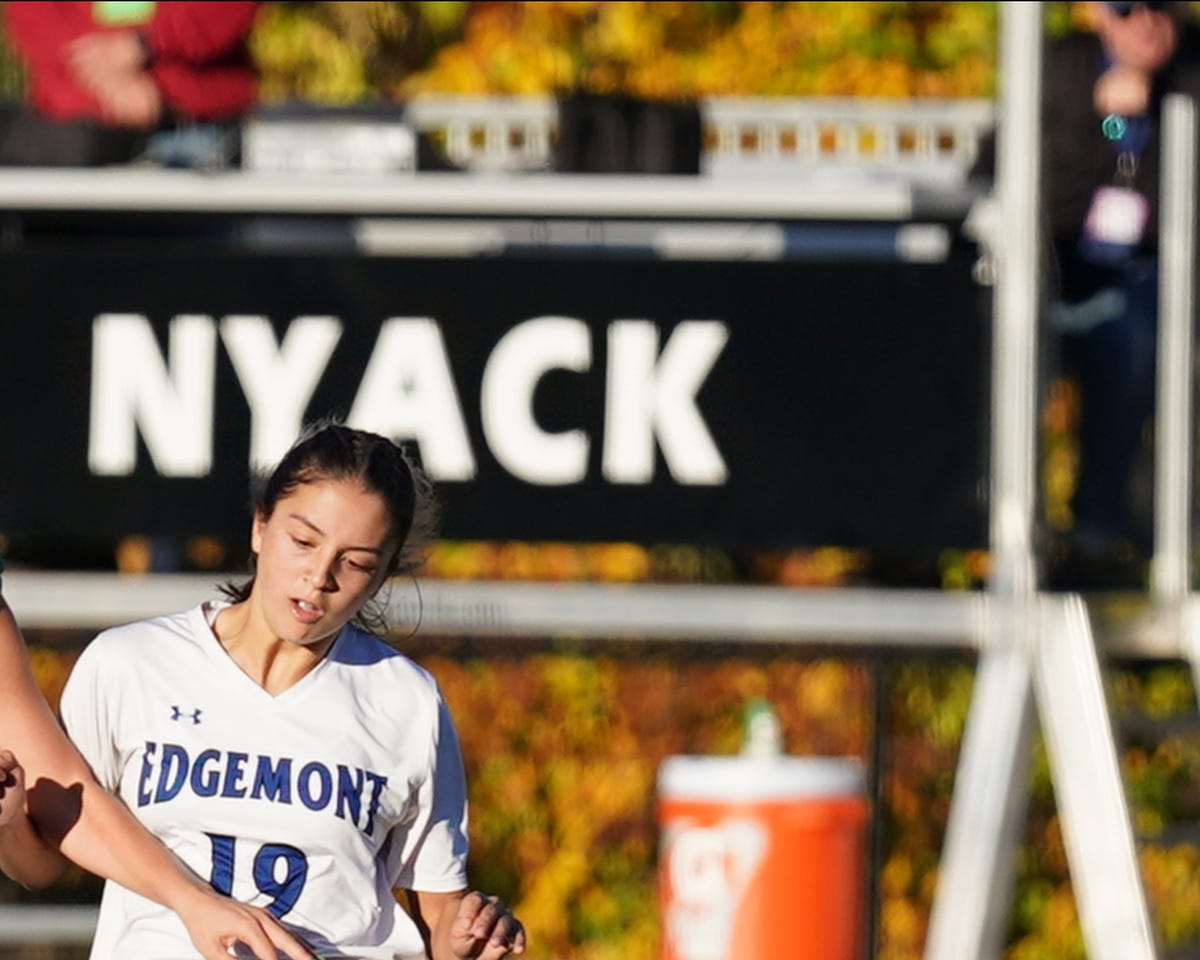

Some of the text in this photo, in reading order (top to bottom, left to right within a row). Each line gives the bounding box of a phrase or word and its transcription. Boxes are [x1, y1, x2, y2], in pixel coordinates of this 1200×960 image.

[88, 314, 730, 485] NYACK
[137, 741, 388, 836] EDGEMONT
[202, 832, 308, 919] 19
